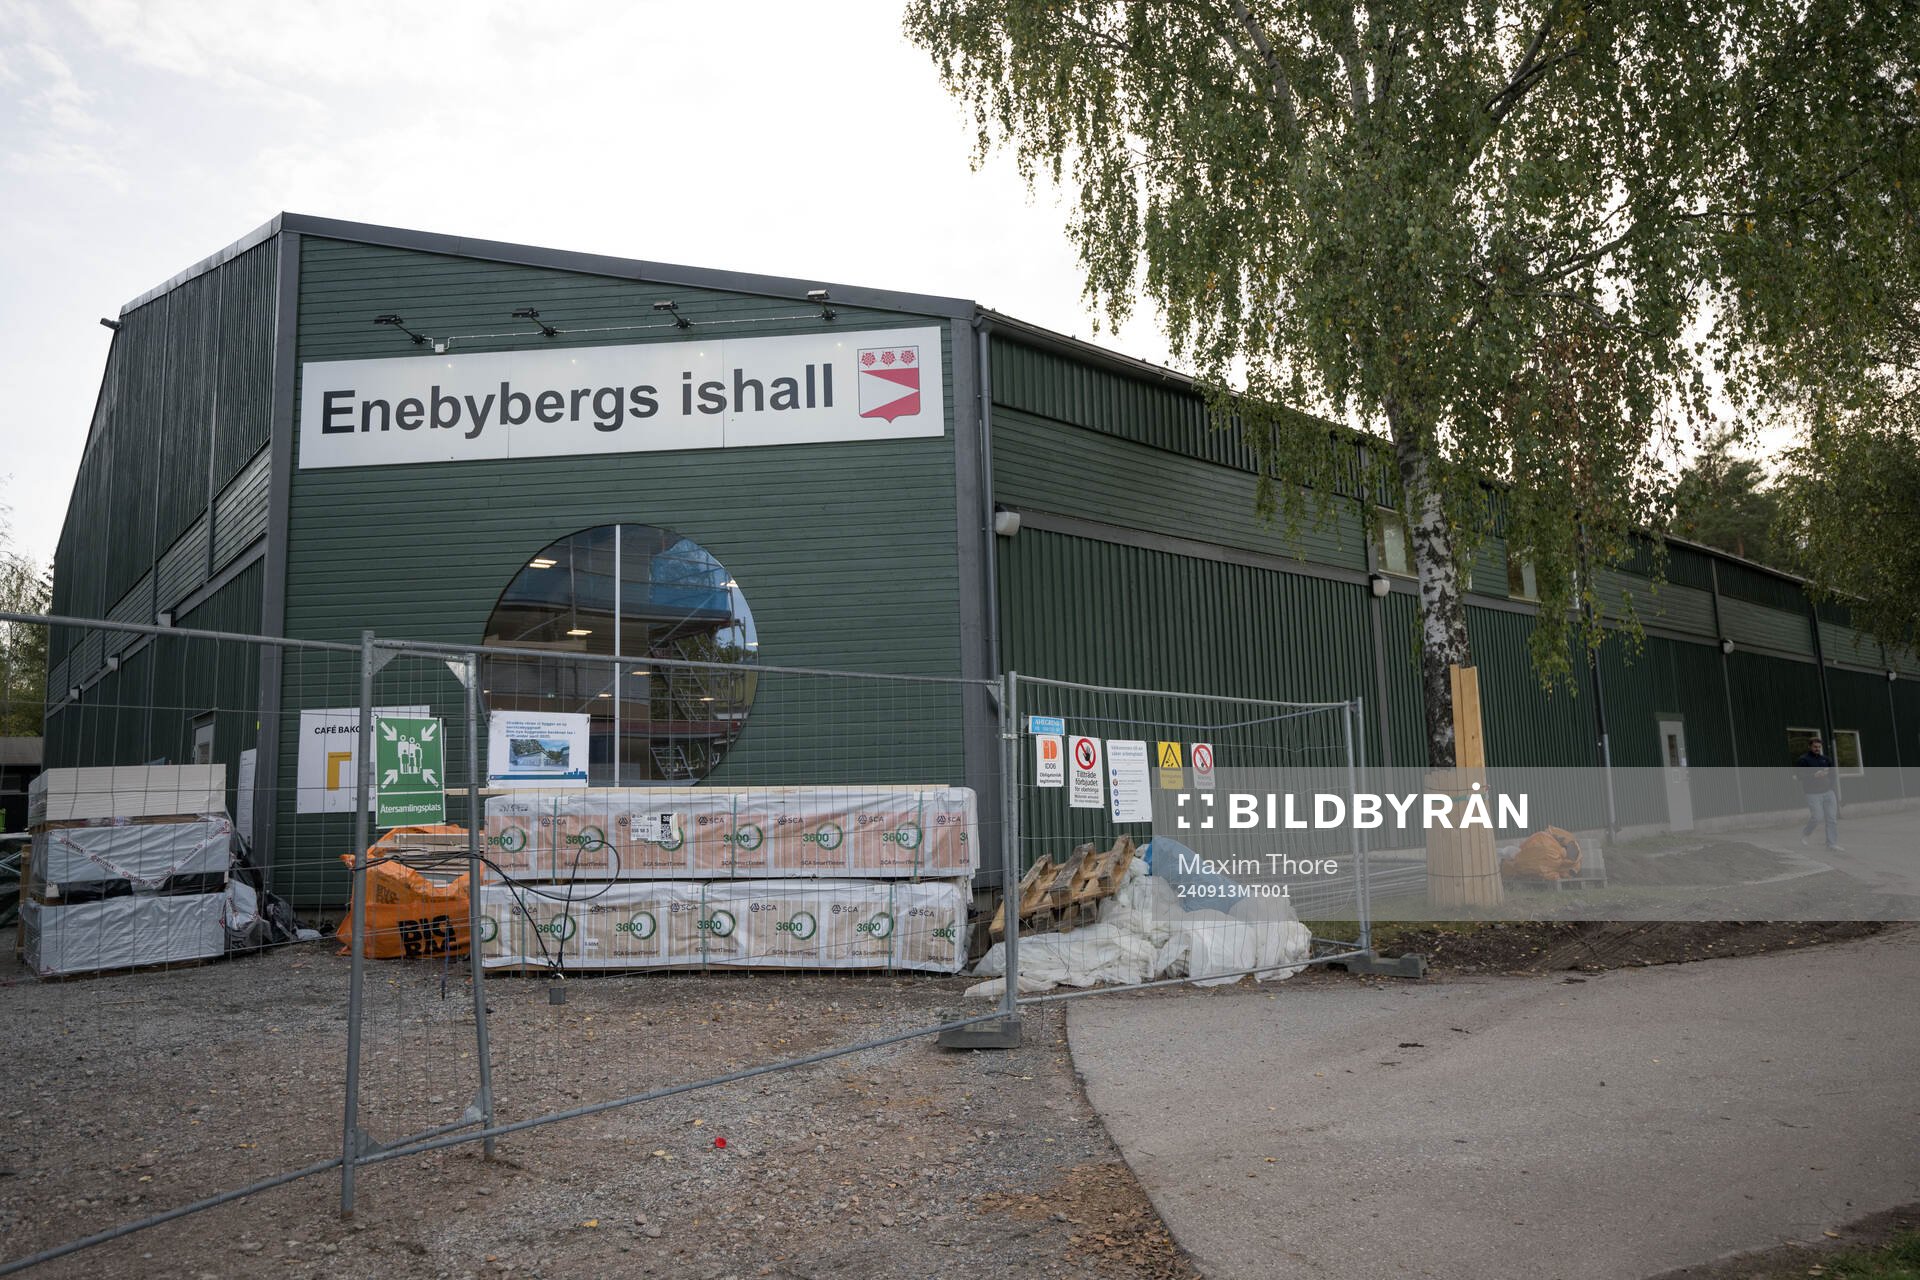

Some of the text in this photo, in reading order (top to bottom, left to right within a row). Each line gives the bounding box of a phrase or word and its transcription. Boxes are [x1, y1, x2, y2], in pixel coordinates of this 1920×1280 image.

[321, 363, 834, 440] Enebybergs ishall
[314, 725, 337, 734] CAFÉ
[1044, 762, 1056, 770] ID06
[1076, 770, 1096, 778] Tillträde
[1075, 778, 1098, 787] förbjudet
[380, 803, 442, 814] Återsamlingsplats
[488, 836, 513, 846] 3600
[566, 835, 592, 844] 3600
[802, 833, 829, 842] 3600
[882, 832, 909, 842] 3600
[398, 915, 456, 941] BIG
[537, 924, 562, 934] 3600
[616, 922, 642, 932] 3600
[696, 920, 722, 930] 3600
[776, 922, 802, 932] 3600
[856, 922, 881, 932] 3600
